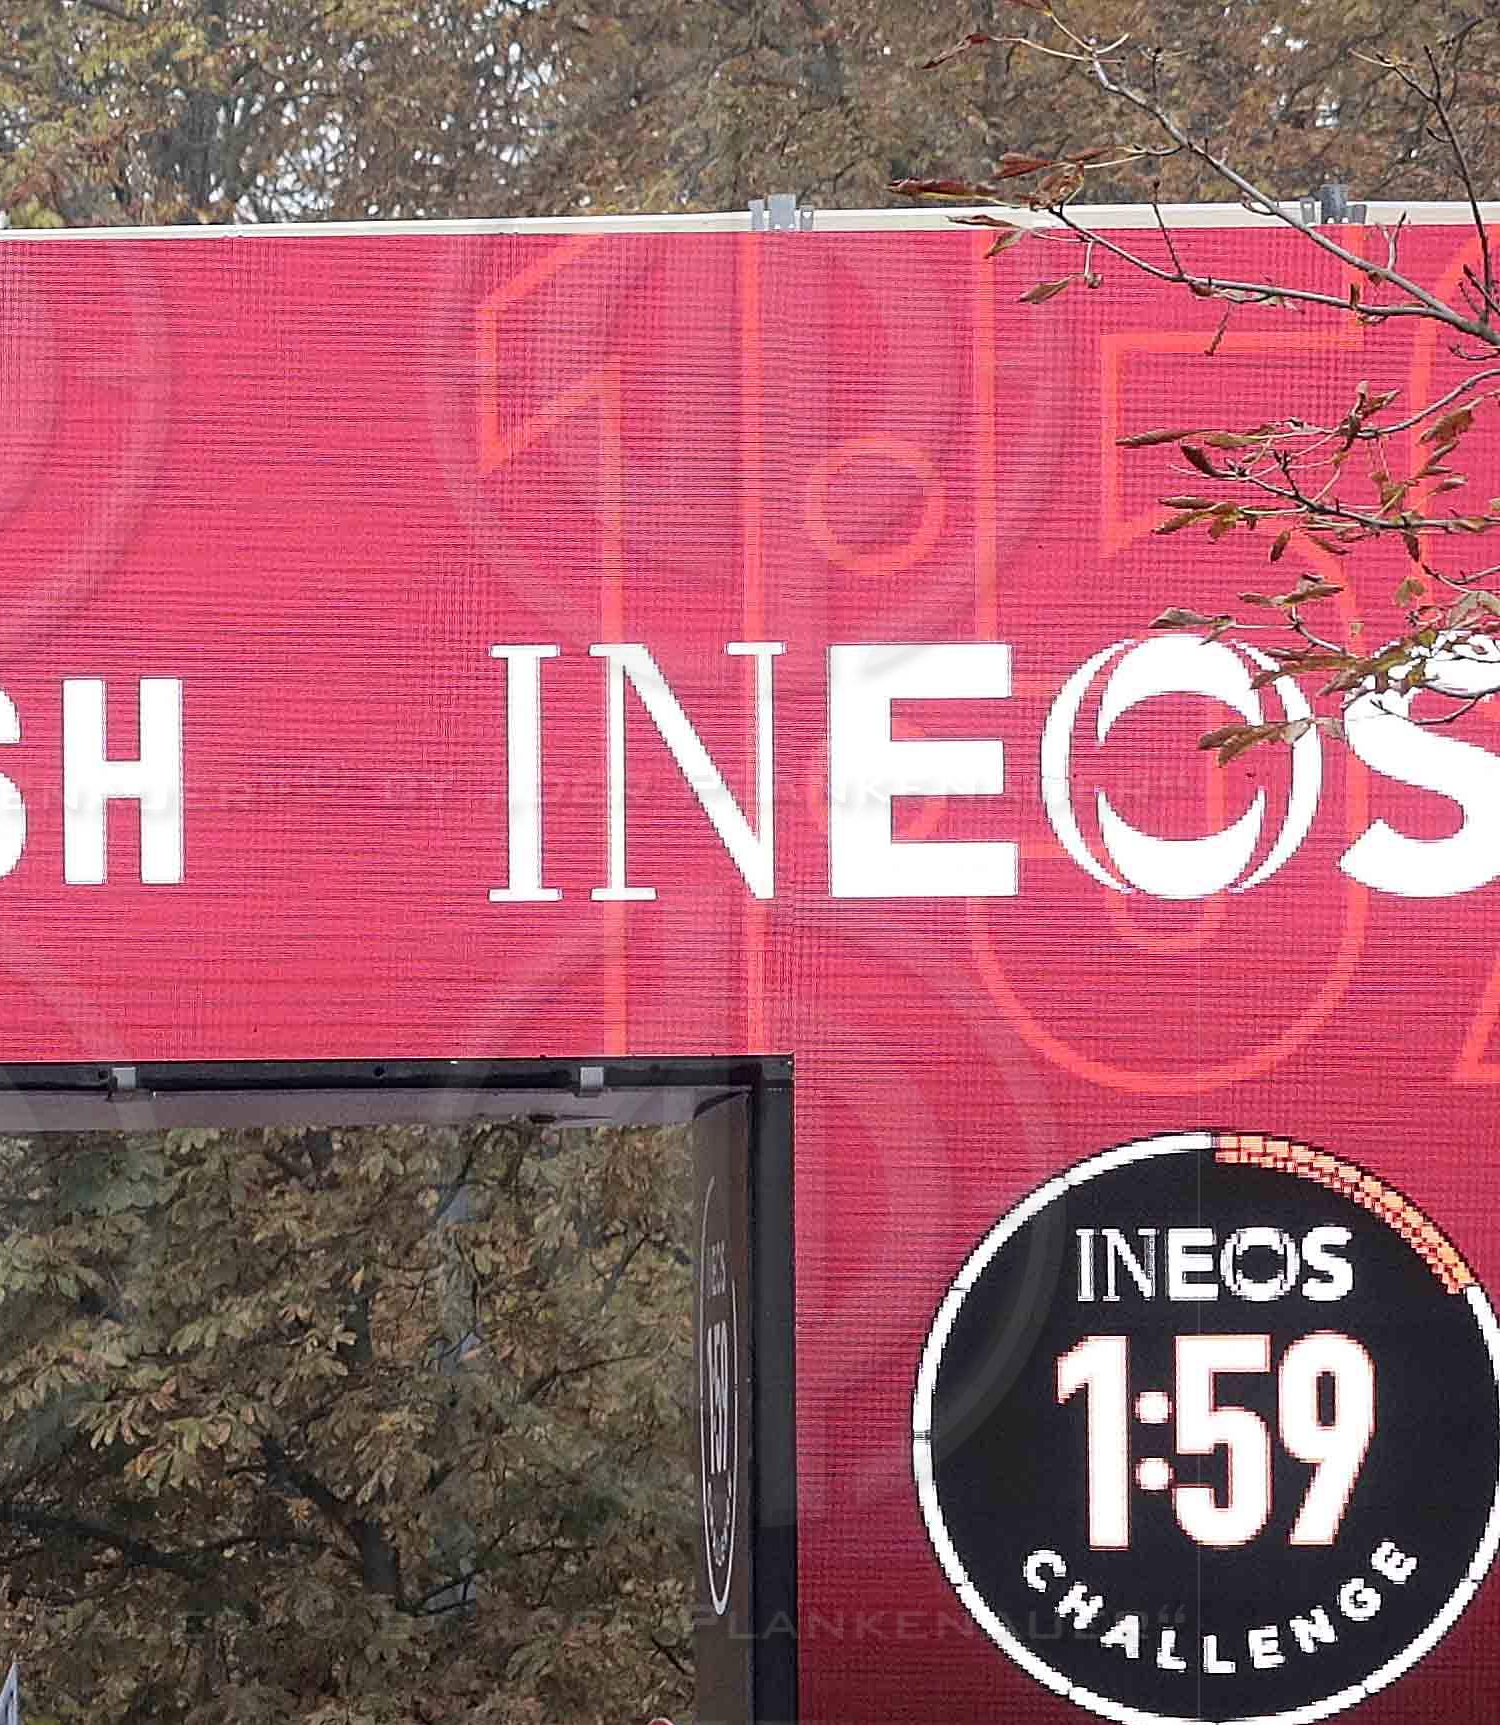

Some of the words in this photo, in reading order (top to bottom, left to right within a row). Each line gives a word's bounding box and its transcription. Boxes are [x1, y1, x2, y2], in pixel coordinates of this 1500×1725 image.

[488, 634, 1500, 903] INEOS
[1075, 1225, 1355, 1303] INEOS
[1055, 1329, 1378, 1552] 1:59
[1022, 1537, 1423, 1675] CHALLENGE
